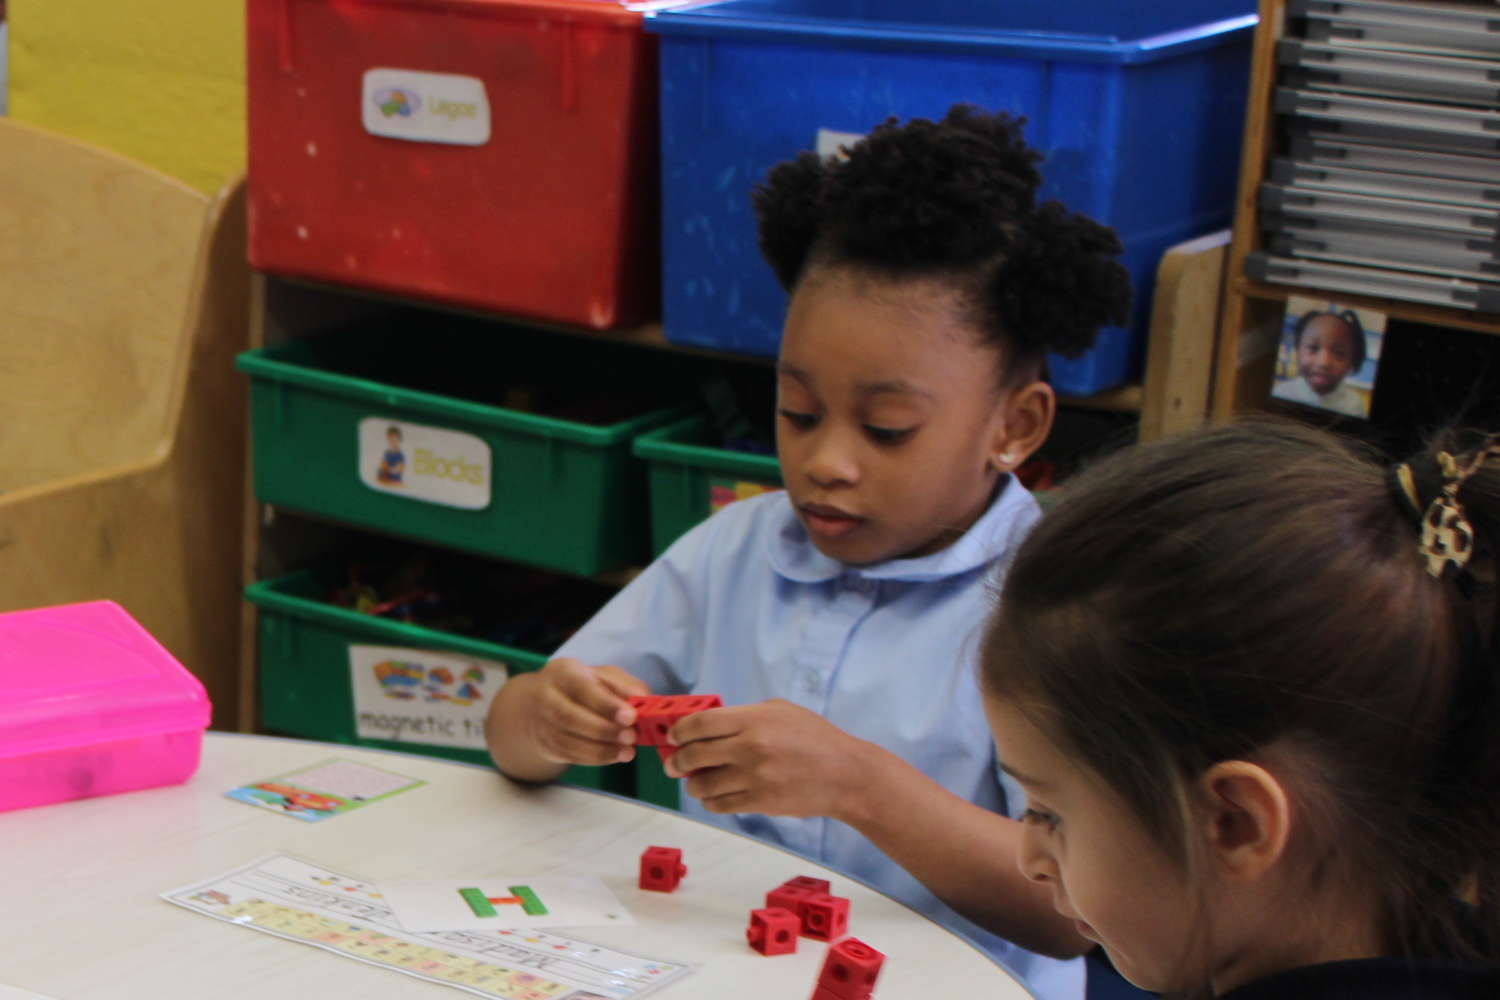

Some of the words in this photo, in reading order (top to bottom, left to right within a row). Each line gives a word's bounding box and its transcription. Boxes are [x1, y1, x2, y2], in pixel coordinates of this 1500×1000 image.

[427, 94, 477, 122] Legos
[413, 447, 485, 487] Blocks
[360, 712, 455, 741] magnetic
[427, 930, 561, 970] Madiso
